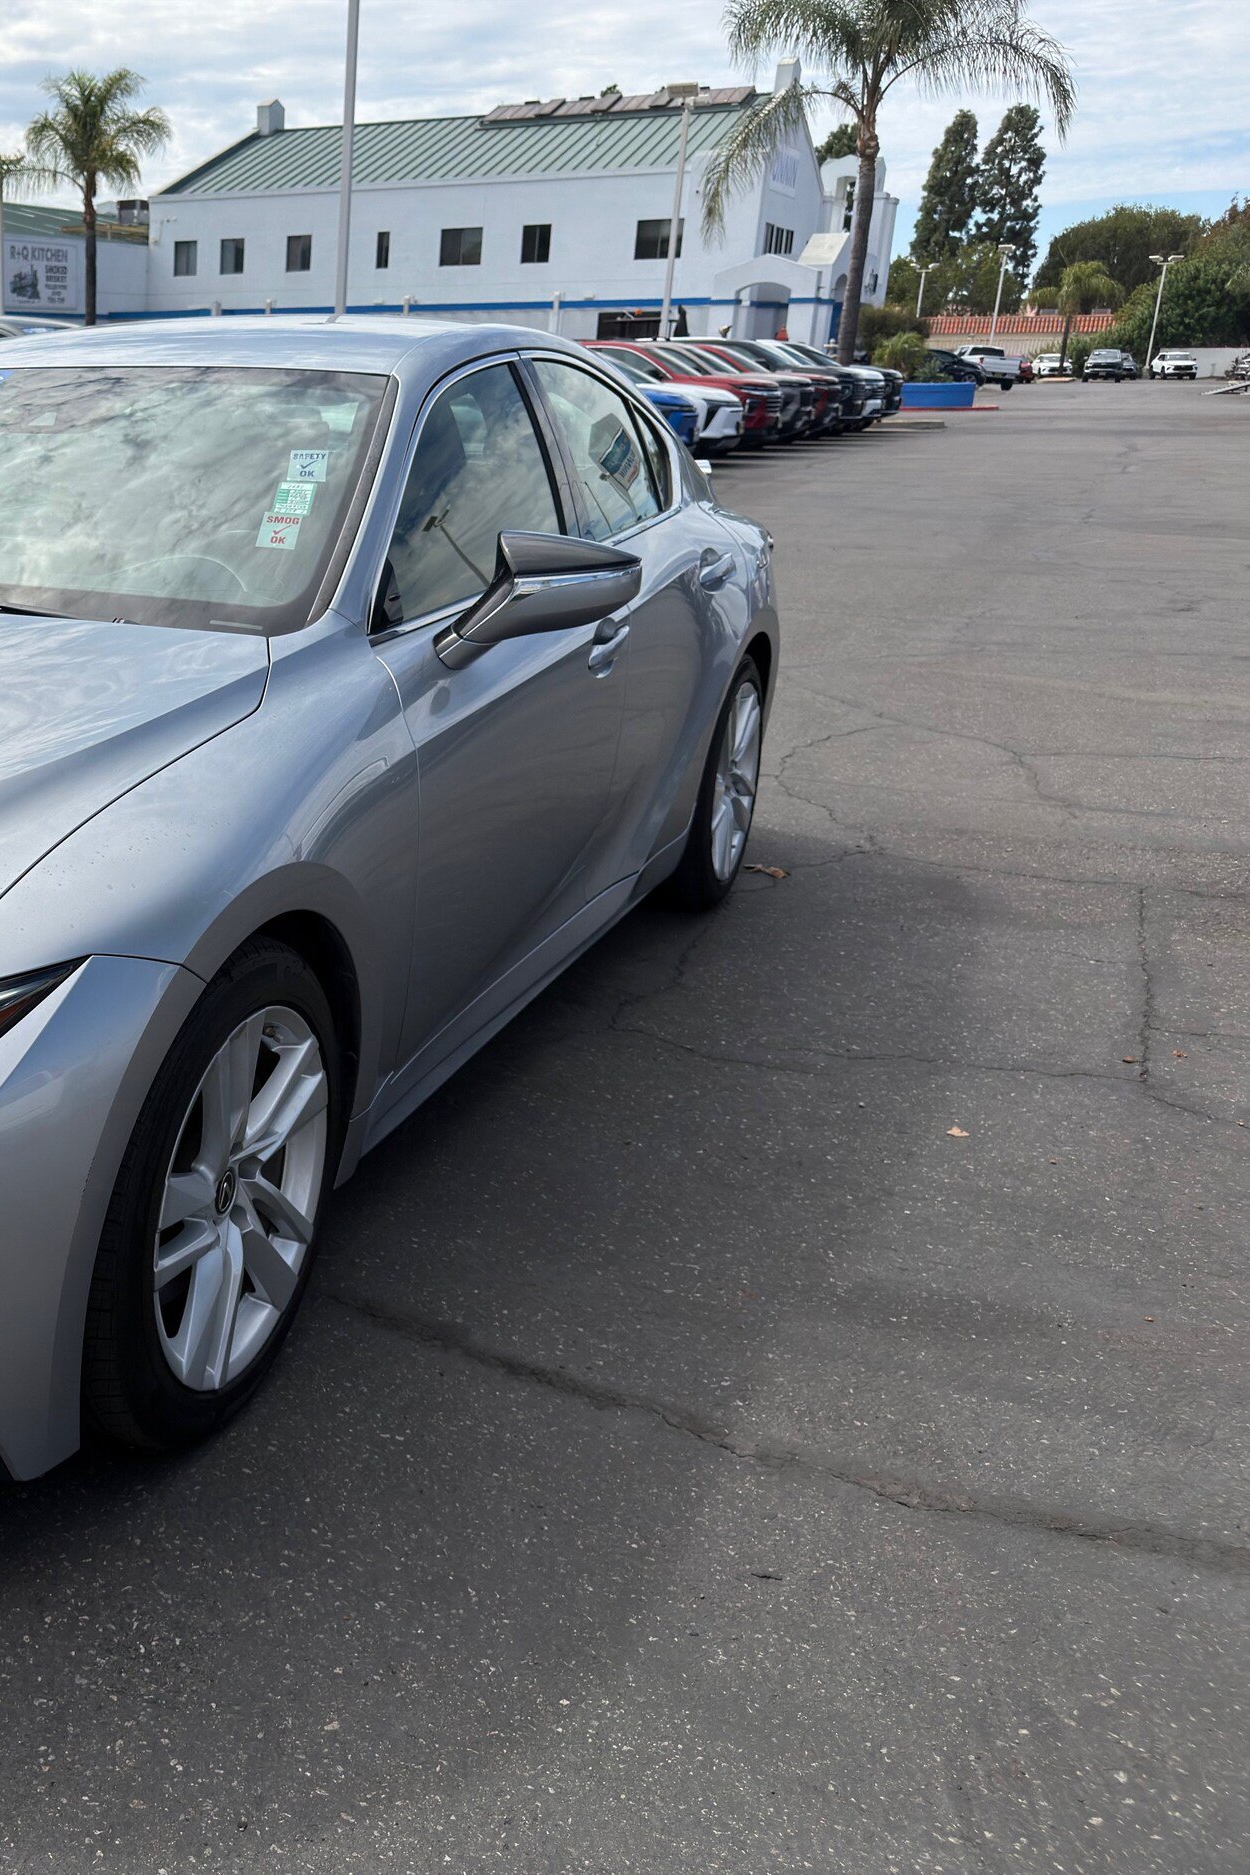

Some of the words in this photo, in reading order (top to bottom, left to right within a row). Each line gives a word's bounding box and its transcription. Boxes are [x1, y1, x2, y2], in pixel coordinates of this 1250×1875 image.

[292, 453, 327, 461] SAFETY
[299, 470, 315, 478] OK
[266, 515, 300, 525] SMOG
[270, 536, 286, 545] OK
